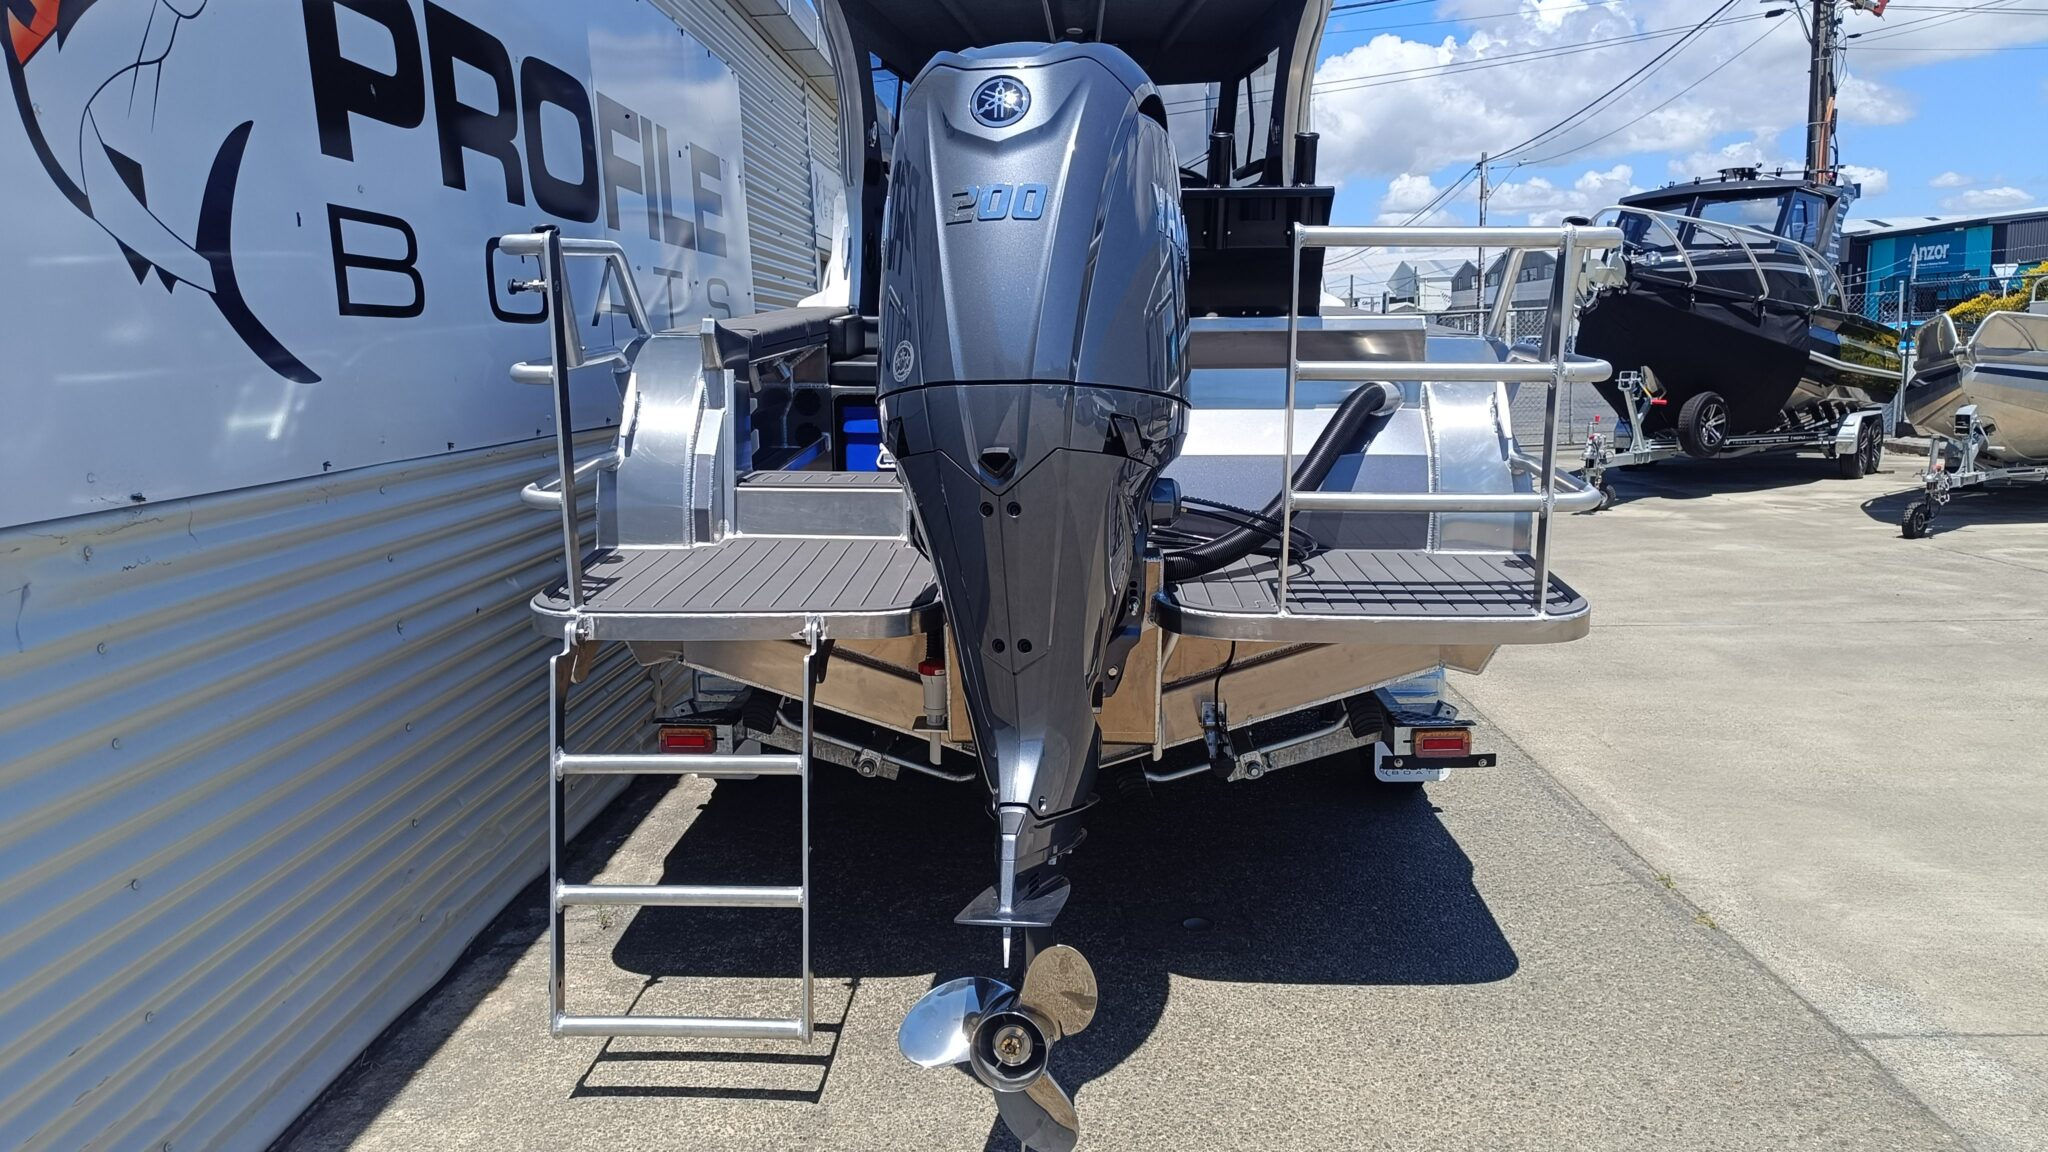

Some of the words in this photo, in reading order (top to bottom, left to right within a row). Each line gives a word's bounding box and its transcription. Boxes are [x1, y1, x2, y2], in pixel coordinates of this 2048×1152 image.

[302, 0, 728, 258] PROFILE
[946, 183, 1048, 226] 200
[327, 203, 732, 329] BOATS
[1908, 243, 1950, 262] Anzor
